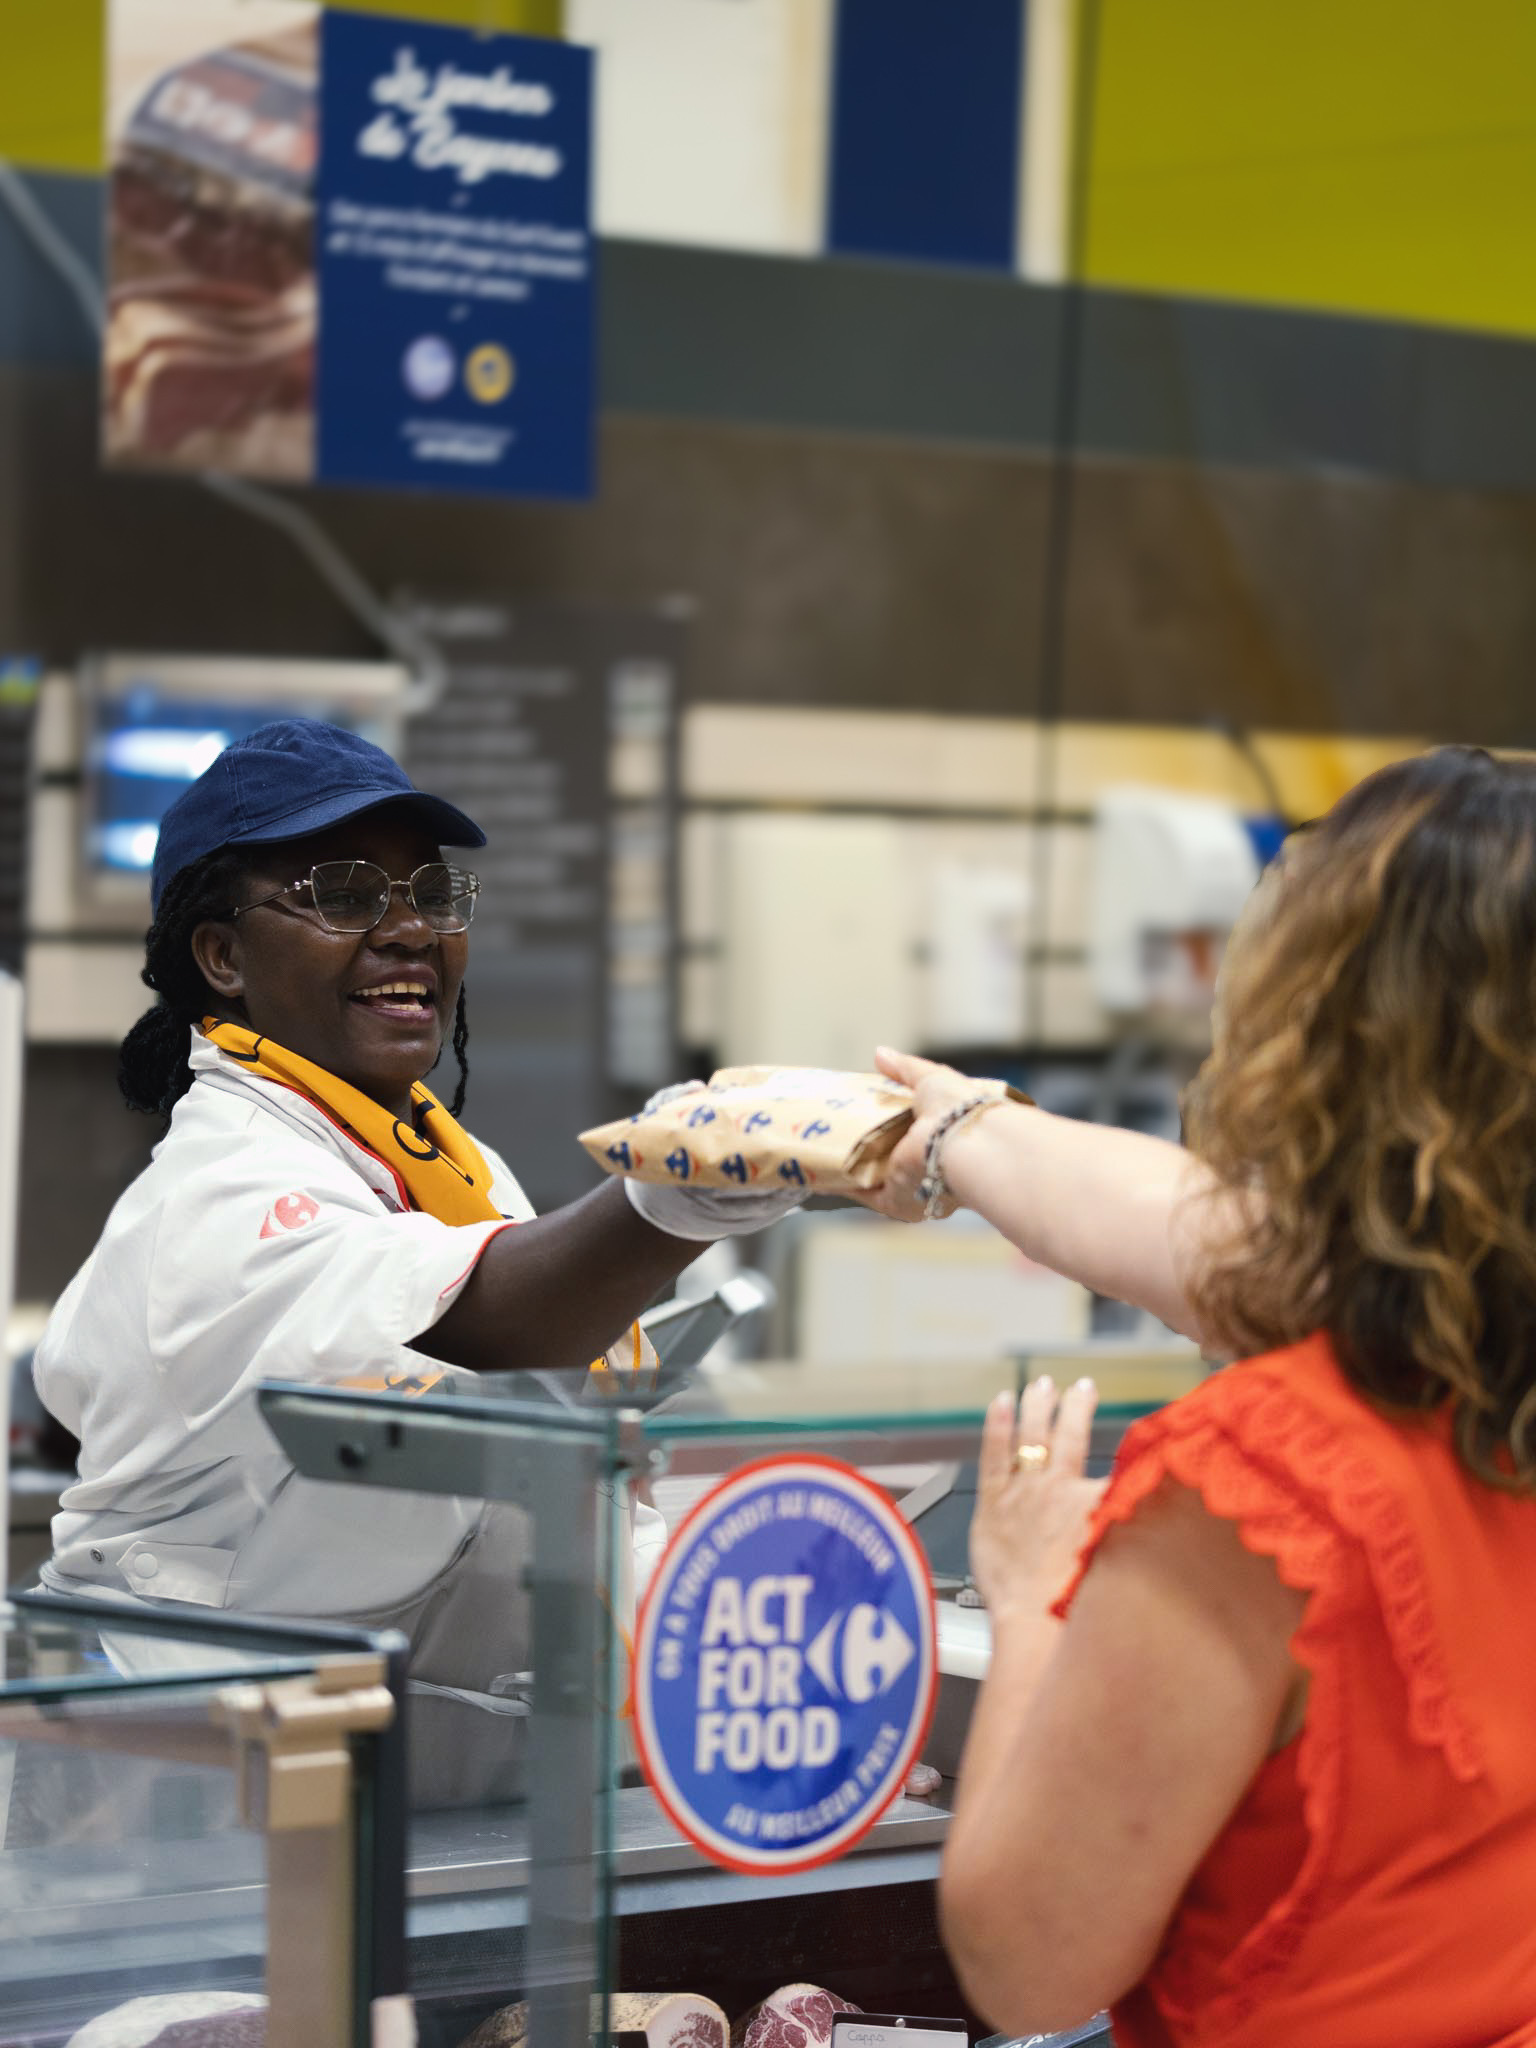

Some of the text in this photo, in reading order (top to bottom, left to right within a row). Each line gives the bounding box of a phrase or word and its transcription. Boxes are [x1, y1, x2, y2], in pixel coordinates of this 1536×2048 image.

[656, 1490, 896, 1680] ON A TOUS DROIT AU MEILLEUR
[701, 1574, 814, 1647] ACT
[697, 1645, 802, 1710] FOR
[694, 1706, 841, 1774] FOOD
[724, 1722, 900, 1841] AU MEILLEUR PRIX
